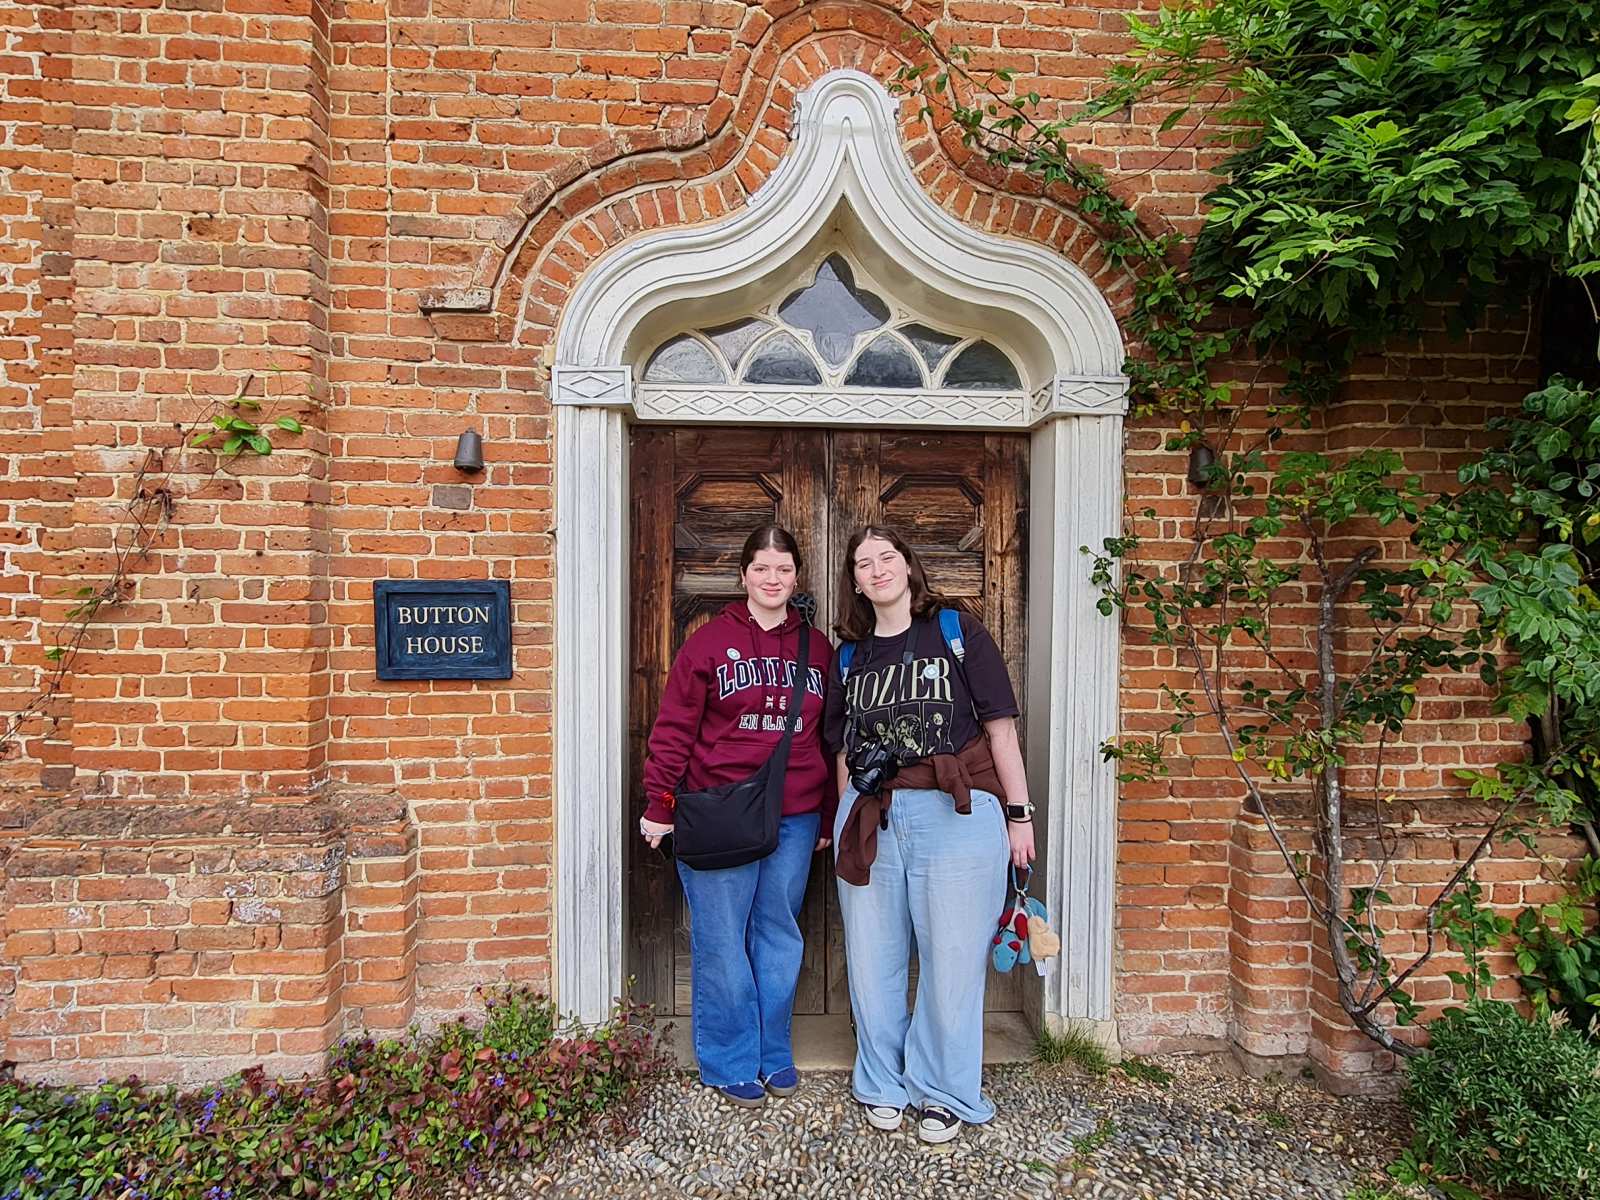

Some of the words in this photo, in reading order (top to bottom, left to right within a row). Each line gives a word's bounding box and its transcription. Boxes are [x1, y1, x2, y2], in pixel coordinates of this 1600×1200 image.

[398, 606, 490, 624] BUTTON
[406, 636, 484, 654] HOUSE
[739, 714, 803, 732] ENLAD
